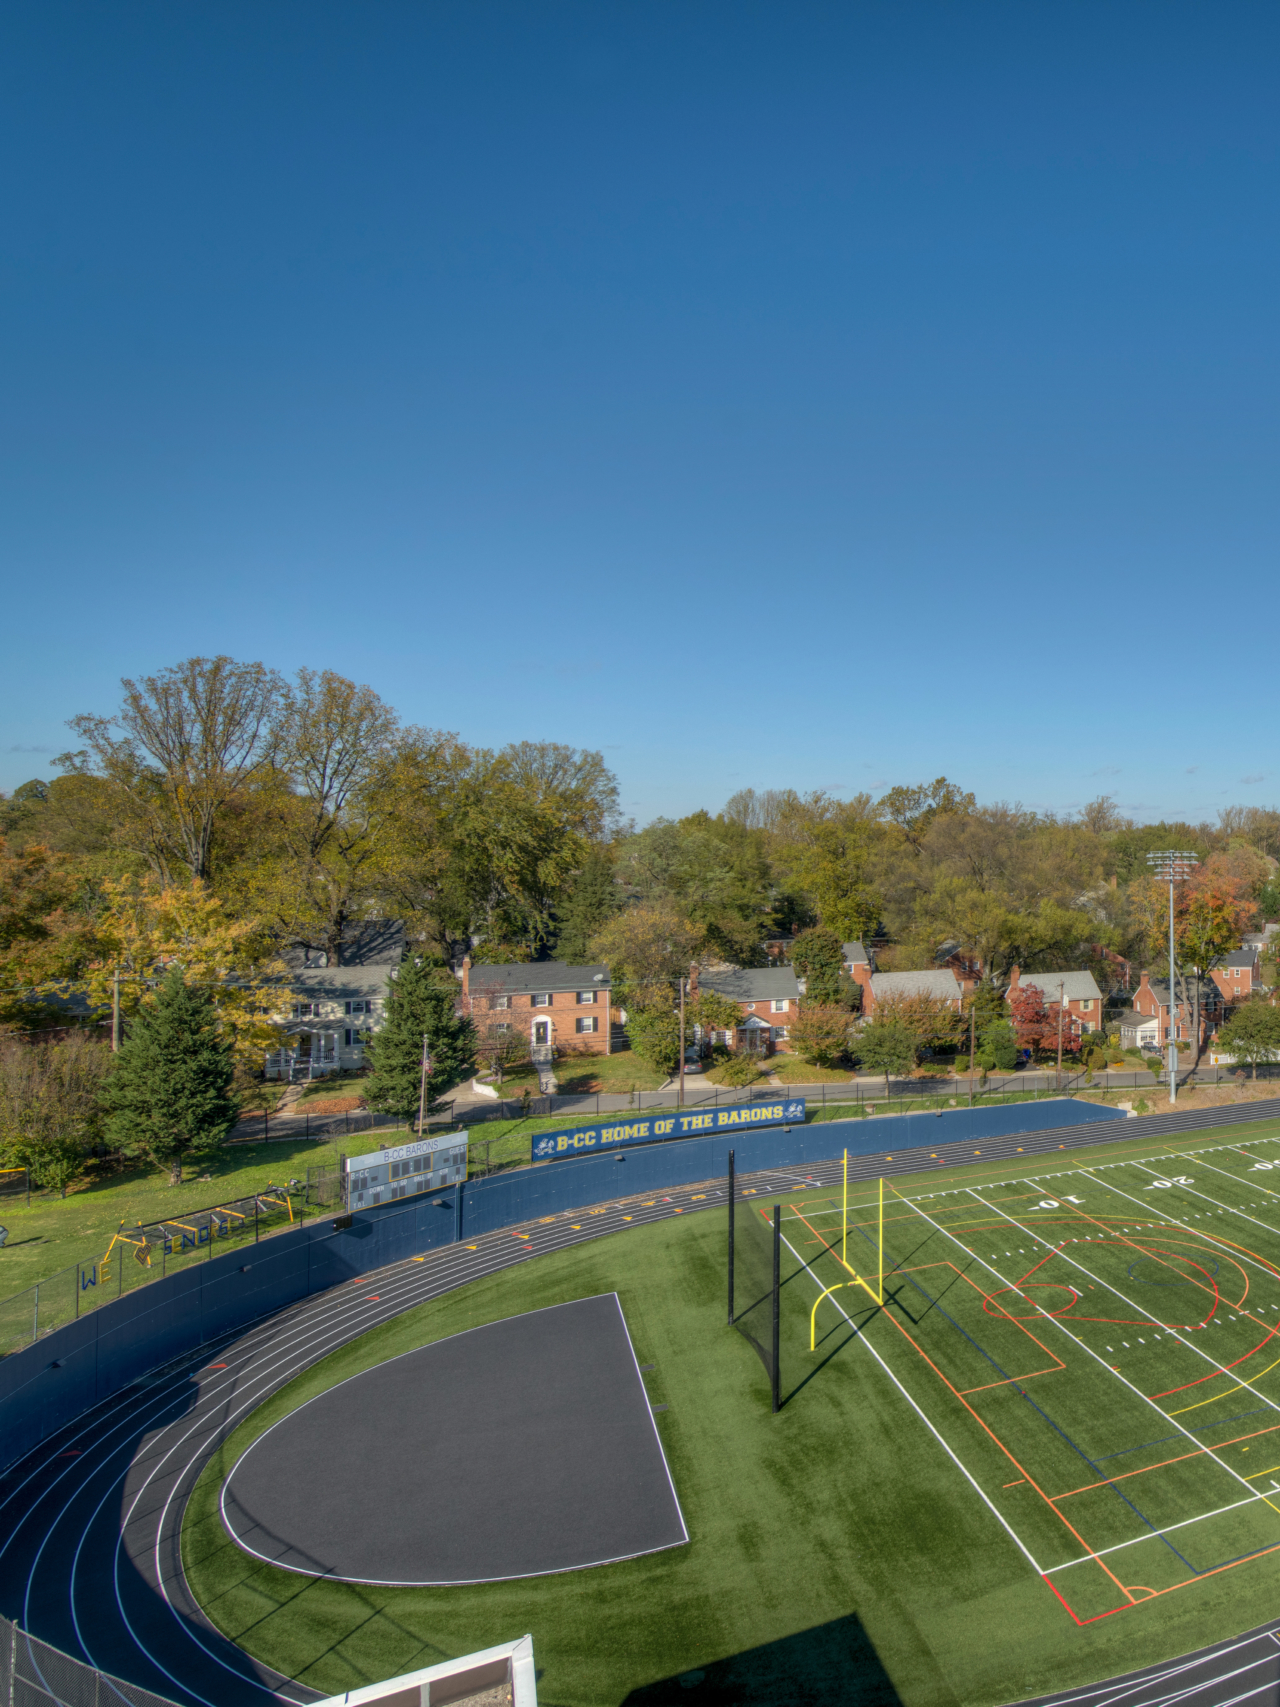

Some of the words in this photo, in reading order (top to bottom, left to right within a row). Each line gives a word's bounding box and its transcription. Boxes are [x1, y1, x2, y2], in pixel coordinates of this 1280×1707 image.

[556, 1131, 596, 1151] B-CC
[601, 1122, 650, 1143] HOME
[654, 1118, 675, 1134] OF
[680, 1114, 713, 1131] THE
[718, 1106, 783, 1126] BARONS
[384, 1149, 404, 1162] B-CC
[405, 1140, 439, 1157] BARONS
[449, 1144, 467, 1155] GUEST
[350, 1168, 370, 1180] B-CC
[1152, 1175, 1195, 1189] 20
[369, 1185, 385, 1195] DOWN
[1038, 1194, 1086, 1209] 10
[81, 1259, 112, 1290] WE
